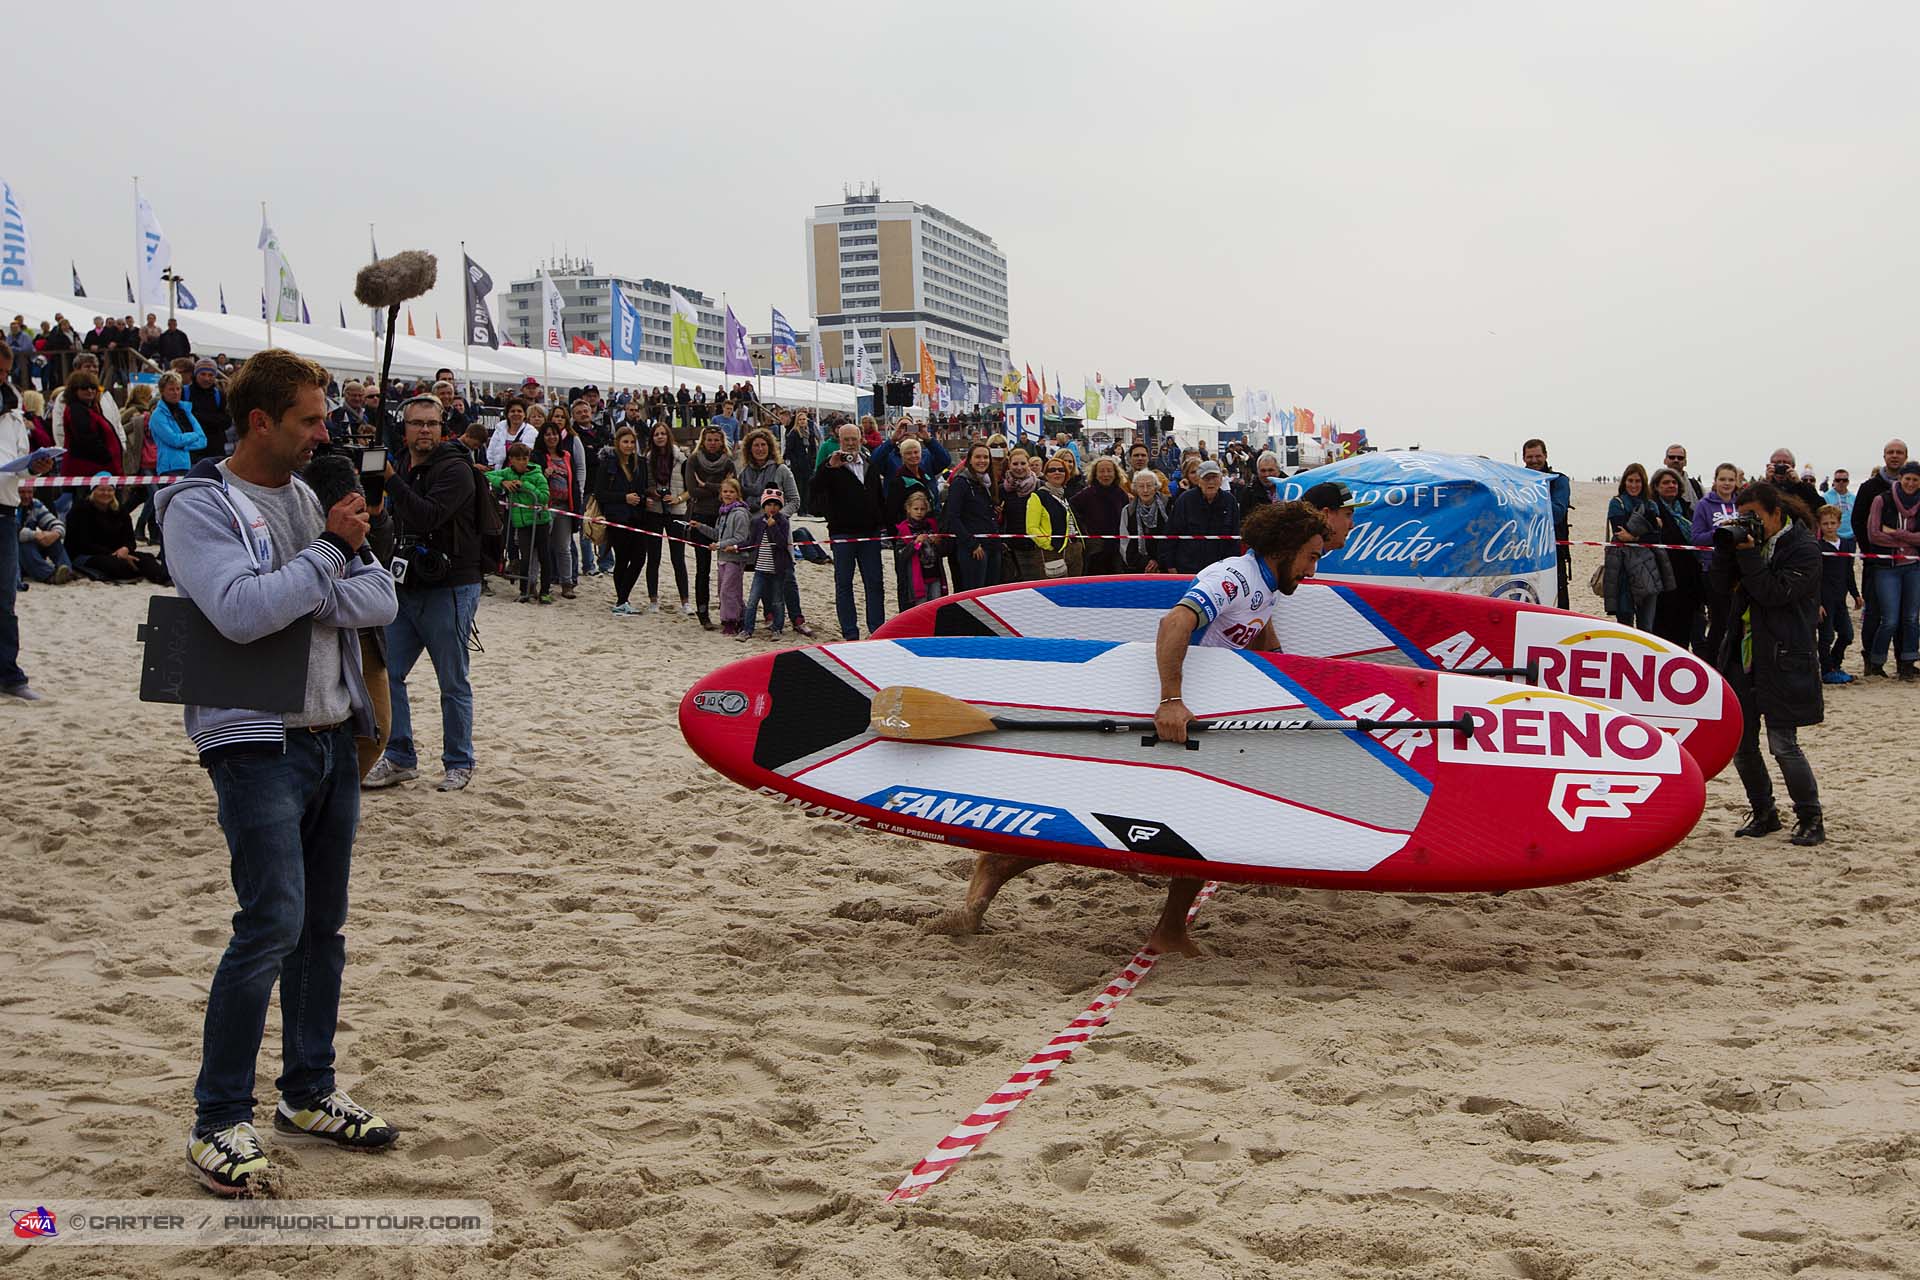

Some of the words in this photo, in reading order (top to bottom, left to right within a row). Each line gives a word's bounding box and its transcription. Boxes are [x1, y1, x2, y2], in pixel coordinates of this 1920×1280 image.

[1283, 482, 1448, 507] DIDOFF
[1343, 520, 1455, 562] Water
[1483, 515, 1538, 563] Cool
[1525, 646, 1709, 706] RENO
[1453, 705, 1662, 760] RENO
[876, 822, 890, 830] FLY
[891, 825, 905, 834] AIR
[906, 828, 945, 841] PREMIUM
[881, 792, 1056, 837] FANATIC
